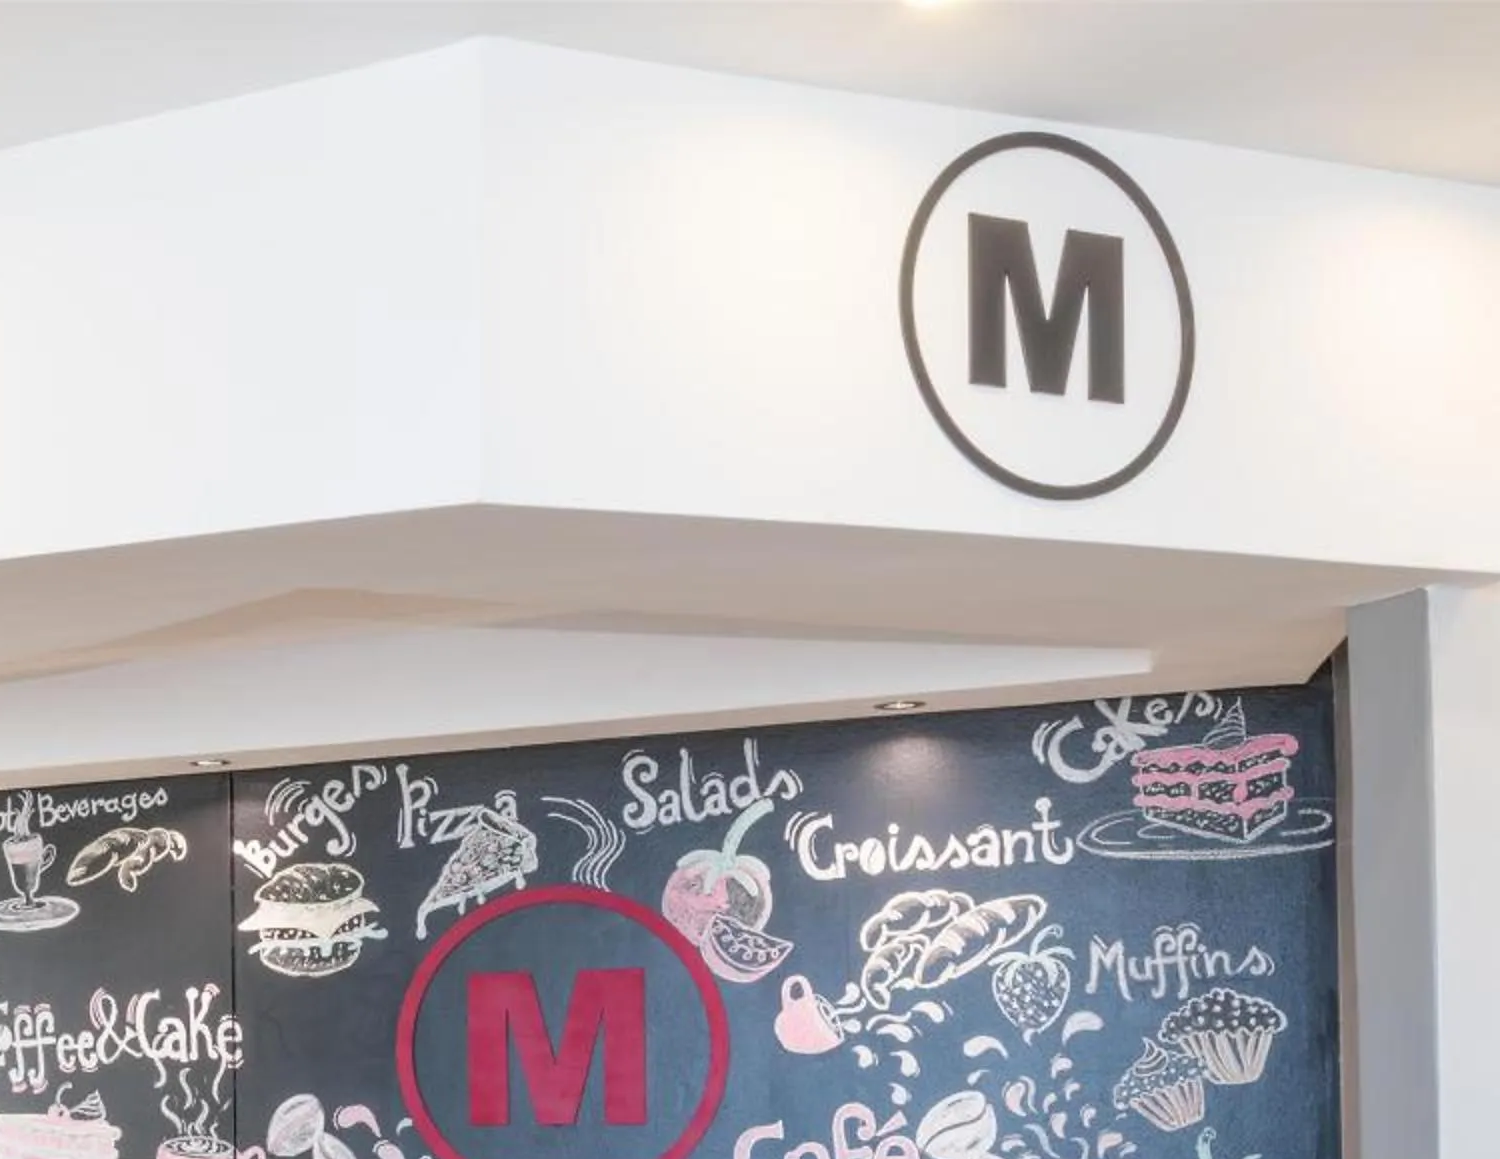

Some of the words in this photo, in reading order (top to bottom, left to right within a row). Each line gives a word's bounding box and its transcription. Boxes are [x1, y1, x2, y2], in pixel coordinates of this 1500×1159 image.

[968, 212, 1125, 405] M
[38, 786, 168, 829] Beverages
[233, 764, 383, 878] Burger
[396, 763, 518, 849] Pizza
[623, 738, 800, 828] Salads
[797, 797, 1075, 881] Croissant
[1086, 926, 1270, 1000] Muffins
[467, 966, 647, 1127] M
